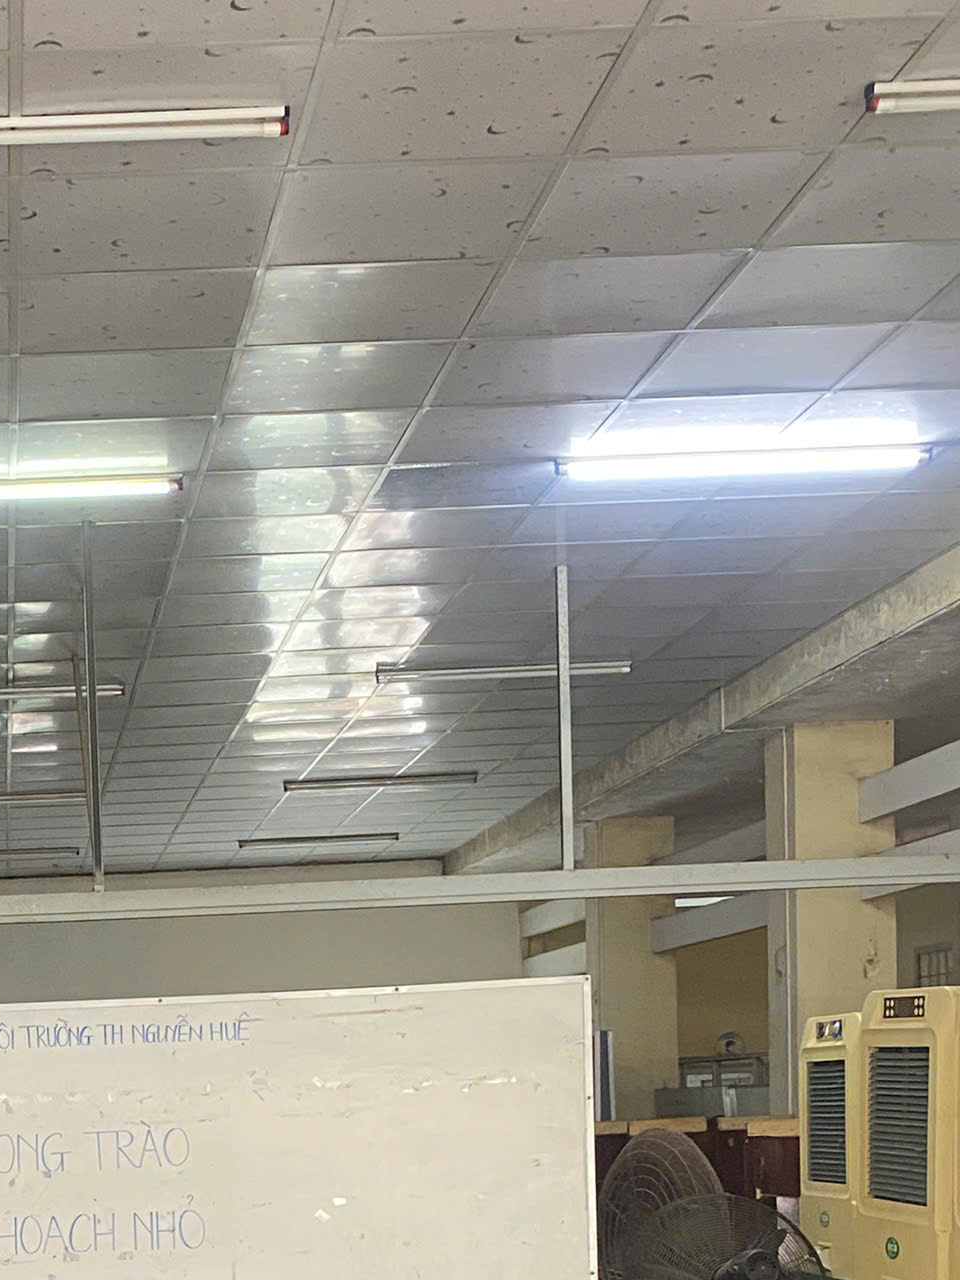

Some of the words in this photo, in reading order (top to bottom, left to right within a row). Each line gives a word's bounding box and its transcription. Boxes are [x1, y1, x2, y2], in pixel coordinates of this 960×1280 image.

[19, 1018, 91, 1048] TRƯỜNG
[96, 1024, 123, 1045] TH
[132, 1014, 203, 1044] NGUYỄN
[210, 1012, 253, 1046] HUỆ
[83, 1120, 189, 1170] TRÀO
[133, 1194, 206, 1250] NHỎ
